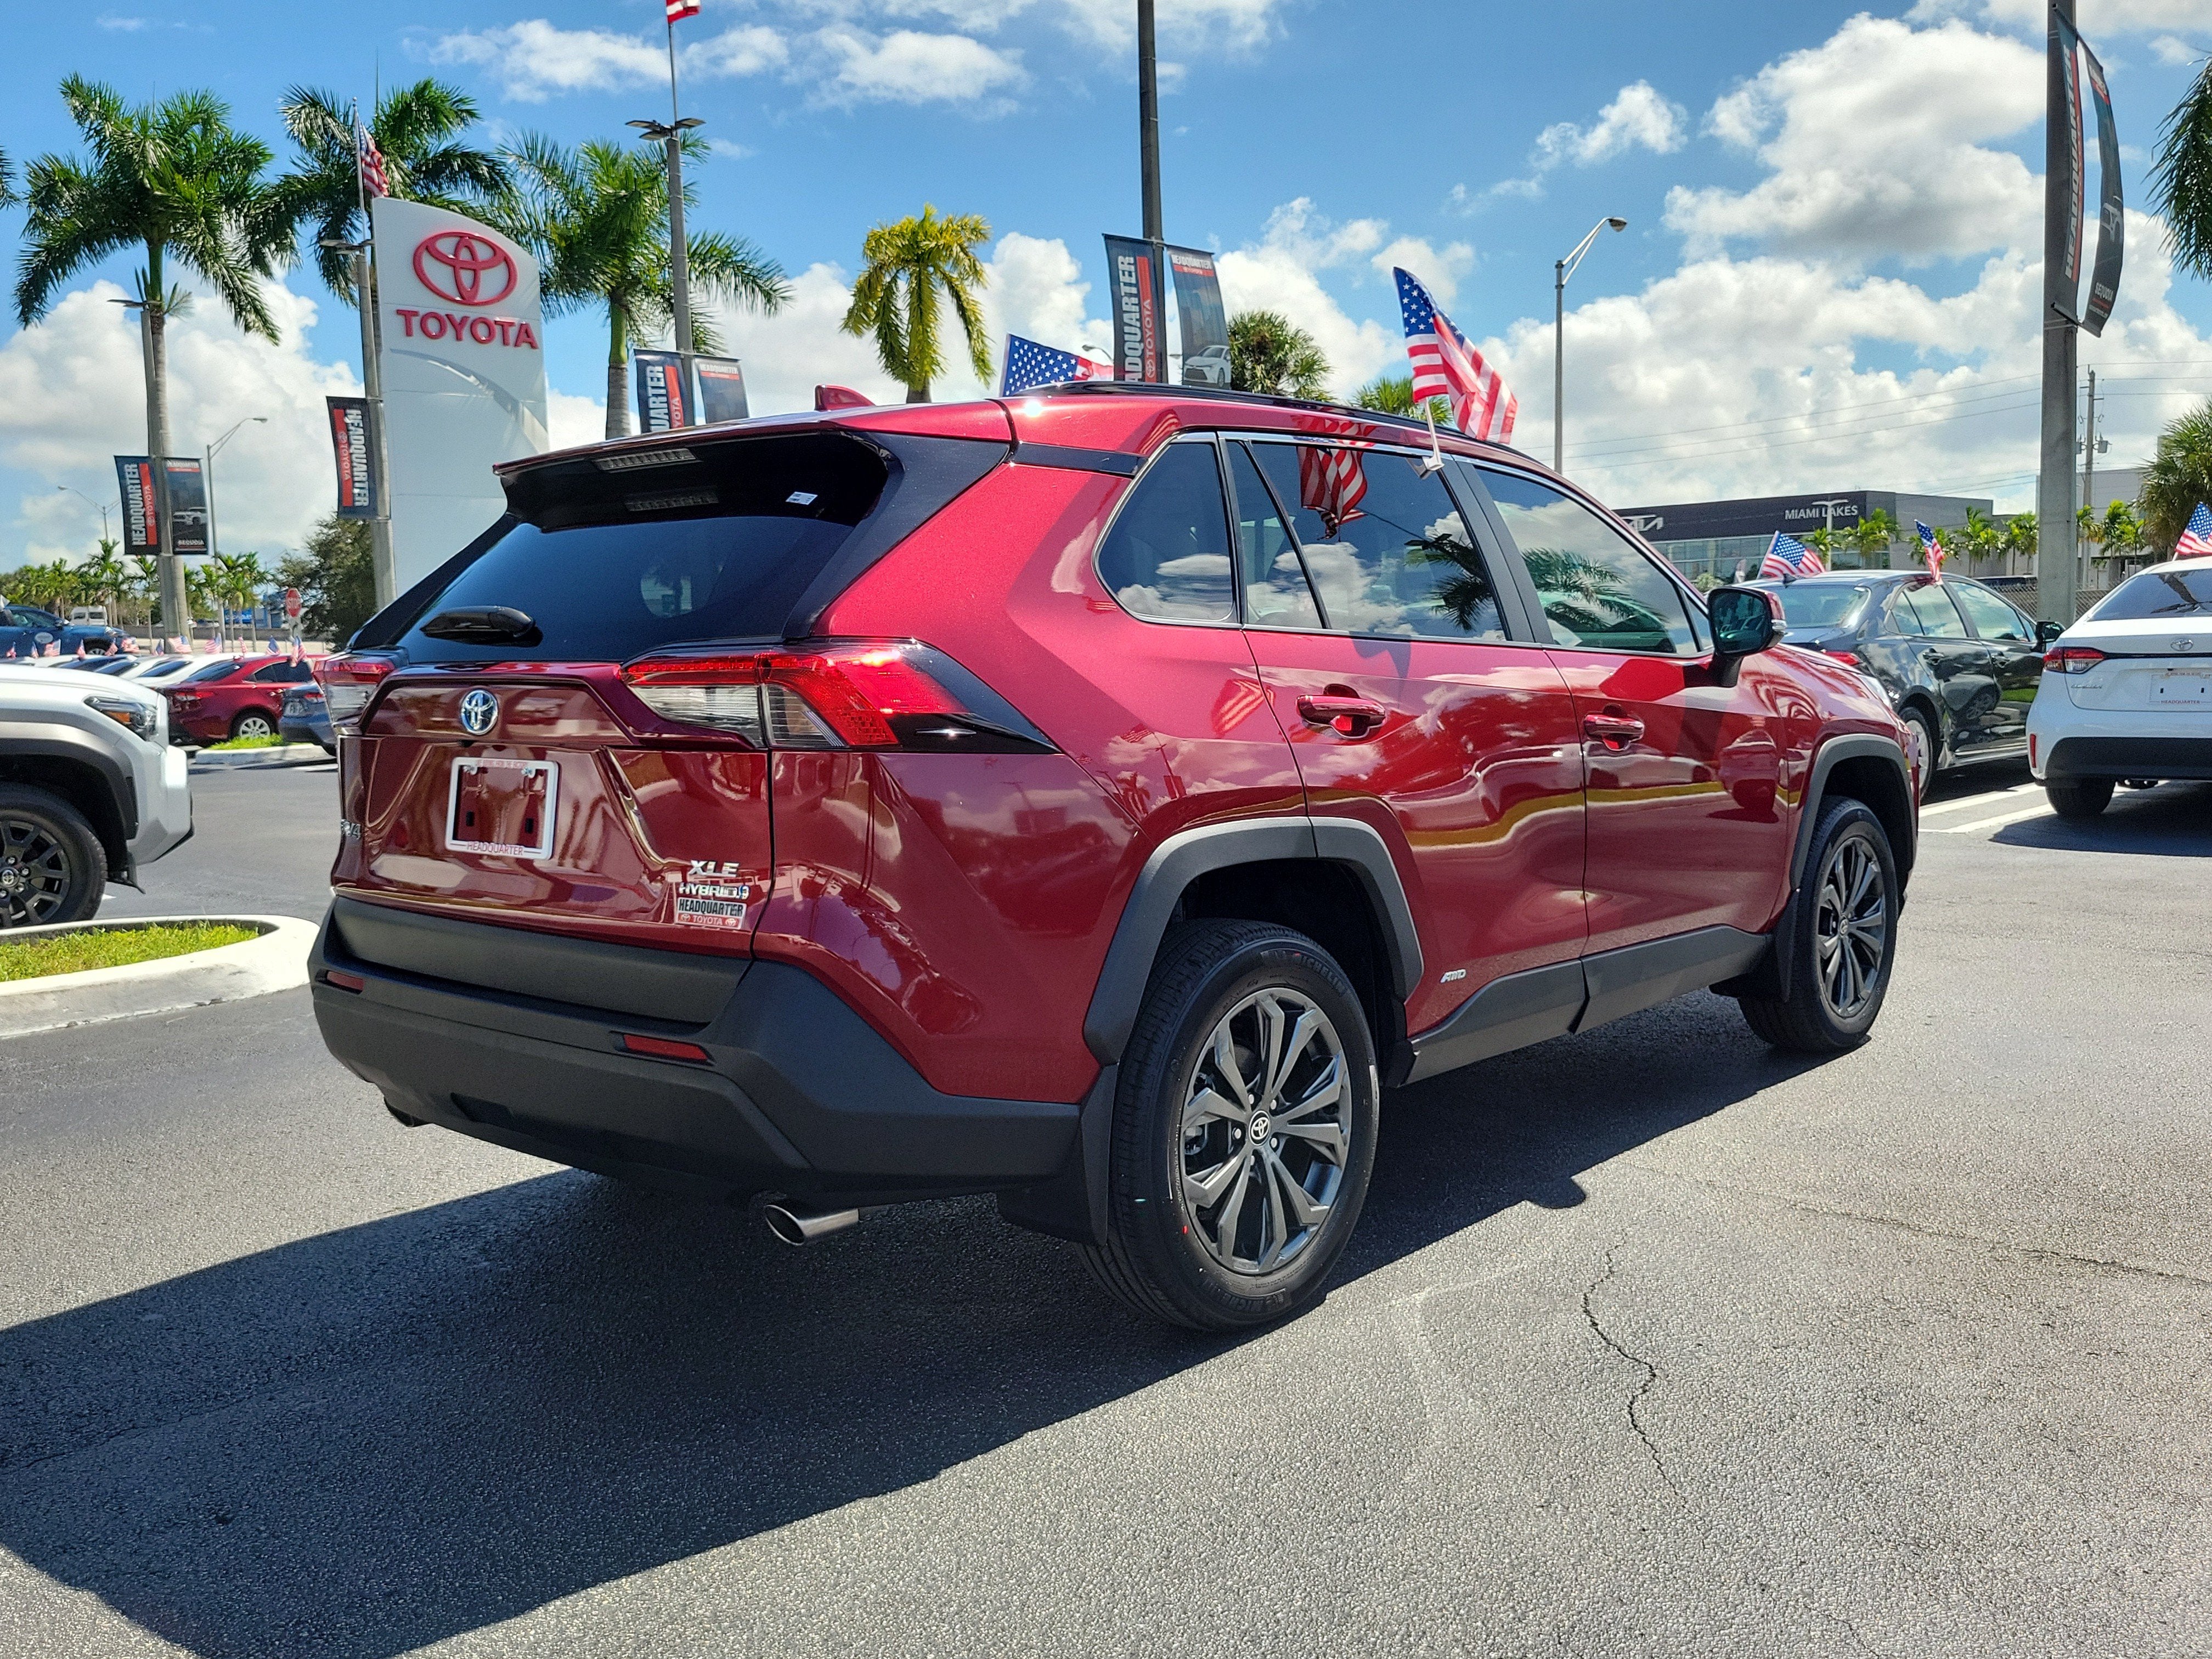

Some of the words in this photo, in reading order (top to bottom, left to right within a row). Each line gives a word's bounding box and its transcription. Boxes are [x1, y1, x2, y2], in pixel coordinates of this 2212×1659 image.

[2063, 44, 2078, 279] HEADQUARTER
[396, 309, 539, 349] TOYOTA
[1118, 255, 1144, 382] ADQUARTER
[1143, 299, 1155, 358] TOYOTA
[646, 365, 670, 432] UARTER
[670, 397, 682, 428] YOTA
[340, 444, 351, 480] TOYOTA
[344, 409, 370, 507] HEADQUARTER
[124, 464, 147, 546] HEADQUARTER
[144, 485, 155, 516] TOYOTA
[1785, 507, 1819, 520] MIAMI
[1821, 505, 1858, 517] LAKES
[467, 842, 523, 856] HEADQUARTER
[688, 860, 739, 878] XLE
[678, 883, 737, 898] HYBRID
[678, 899, 744, 917] HEADQUARTER
[692, 915, 723, 926] TOYOTA
[1440, 969, 1466, 983] AWD
